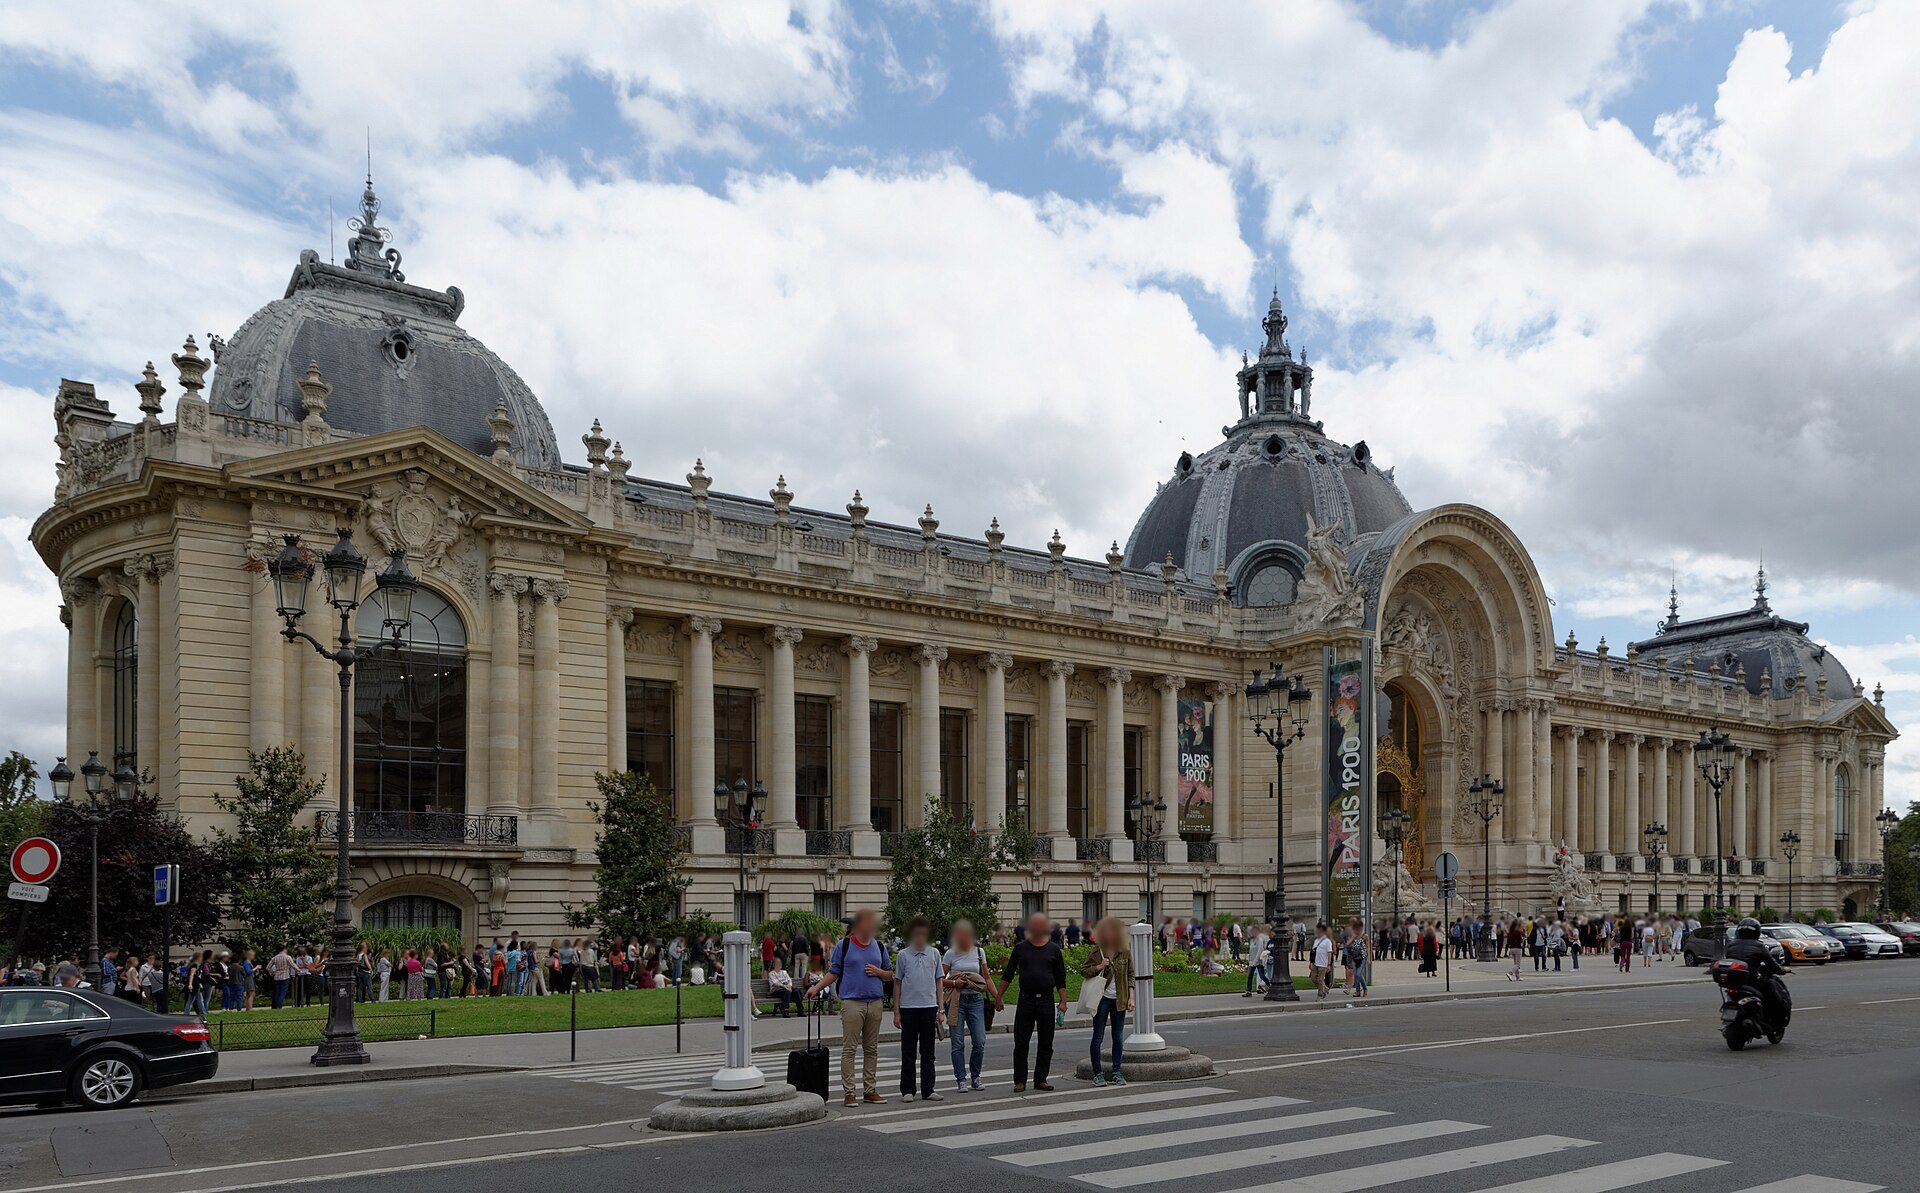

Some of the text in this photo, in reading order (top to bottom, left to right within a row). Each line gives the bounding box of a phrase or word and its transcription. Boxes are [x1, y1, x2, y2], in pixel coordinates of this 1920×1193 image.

[1181, 753, 1209, 768] PARIS
[1185, 769, 1206, 782] 1900
[1342, 736, 1360, 863] PARIS 1900
[11, 891, 42, 900] POMPIERS
